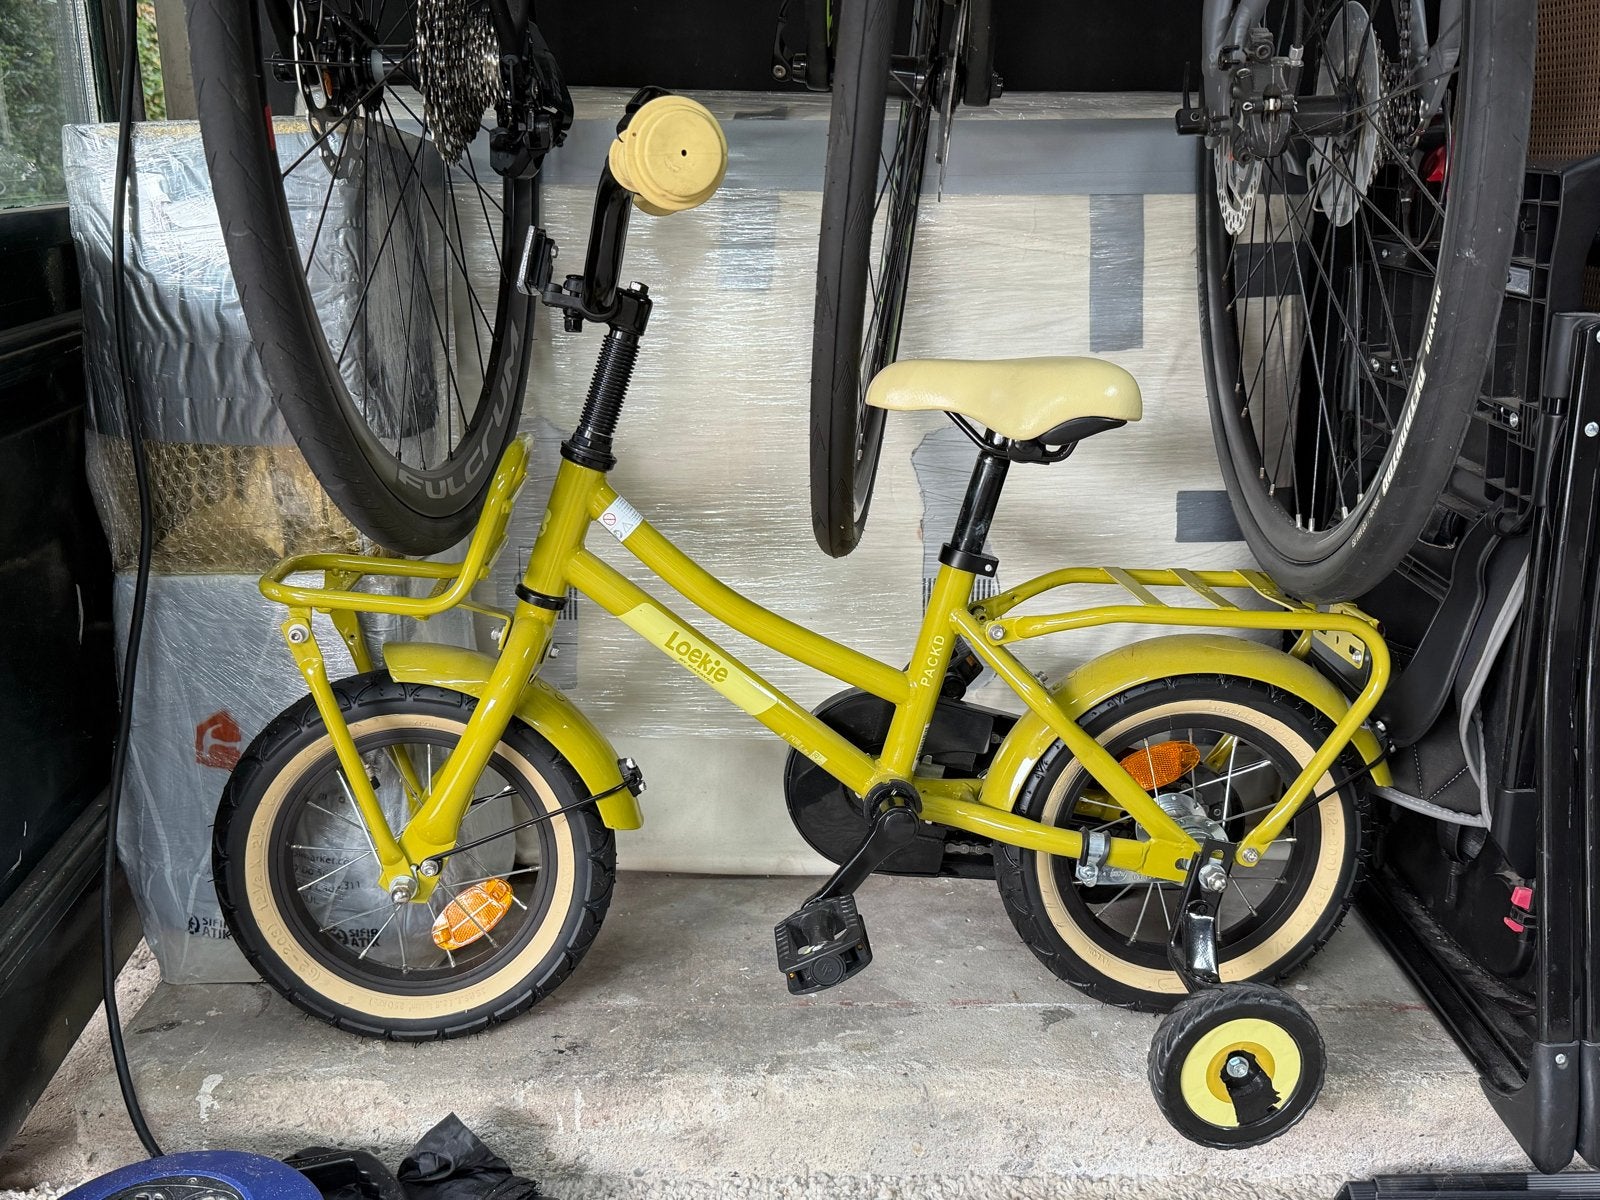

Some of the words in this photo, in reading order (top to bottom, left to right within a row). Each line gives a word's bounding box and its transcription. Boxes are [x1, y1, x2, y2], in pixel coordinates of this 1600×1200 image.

[1425, 284, 1441, 354] MAXXIS
[664, 631, 729, 683] Loekie
[920, 635, 945, 687] PACKD
[202, 917, 226, 928] SIFI
